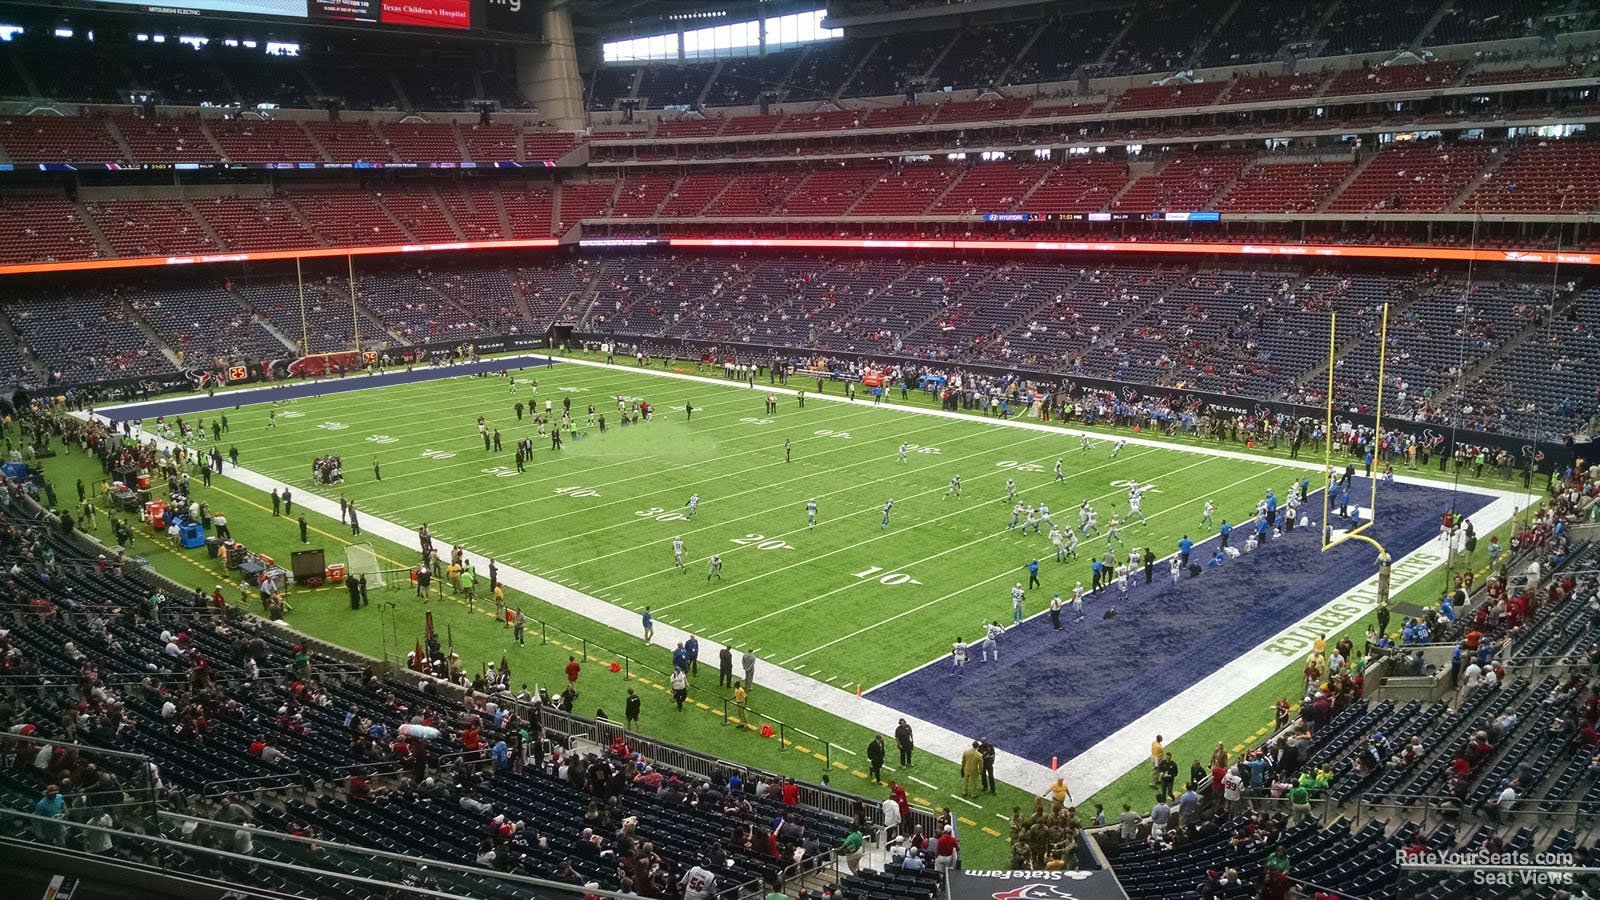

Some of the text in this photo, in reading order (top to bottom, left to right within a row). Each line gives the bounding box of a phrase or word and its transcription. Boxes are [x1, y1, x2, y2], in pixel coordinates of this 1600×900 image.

[383, 4, 466, 18] Texas Children's Hospital
[230, 368, 245, 378] 25
[1209, 403, 1248, 415] TEXANS
[553, 486, 597, 498] 40
[635, 507, 684, 522] 30
[729, 533, 787, 551] 20
[850, 566, 911, 585] 10
[1264, 603, 1362, 657] SERVICE
[1417, 629, 1429, 639] 90
[1225, 780, 1238, 792] 99
[690, 876, 705, 892] 56
